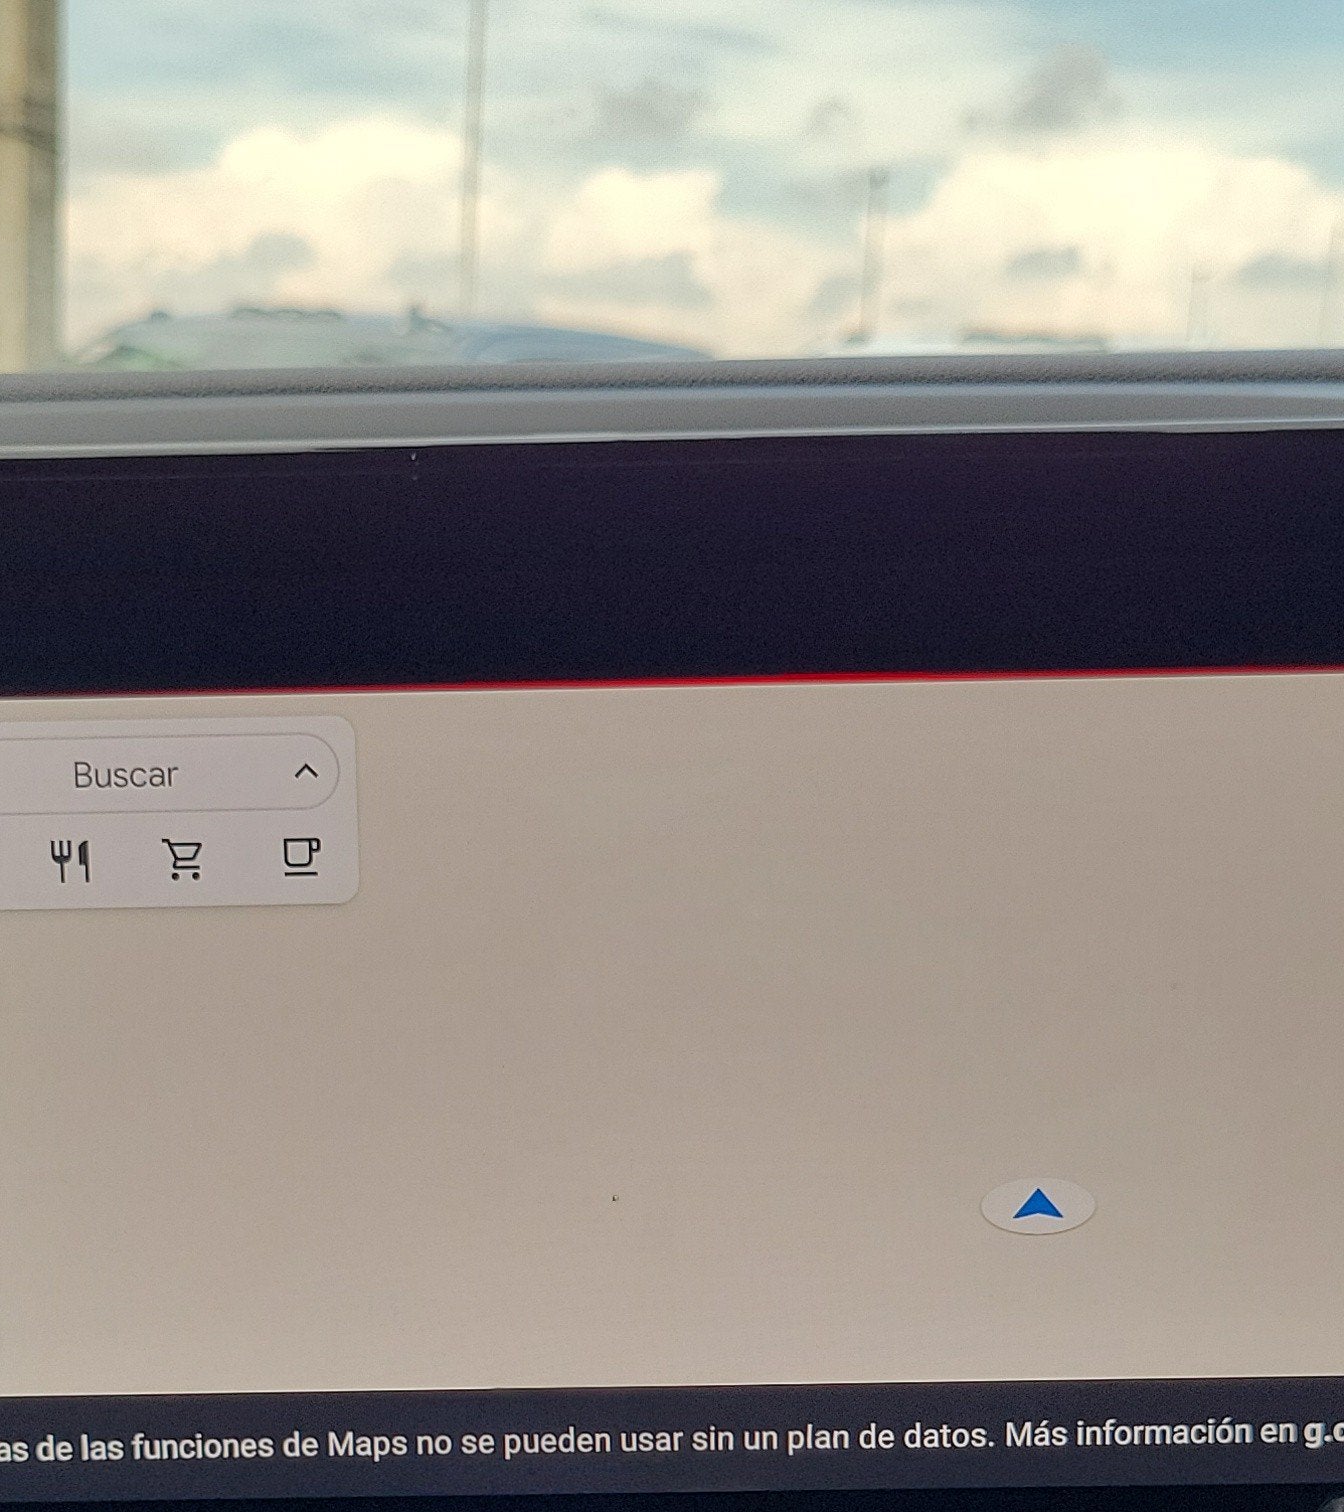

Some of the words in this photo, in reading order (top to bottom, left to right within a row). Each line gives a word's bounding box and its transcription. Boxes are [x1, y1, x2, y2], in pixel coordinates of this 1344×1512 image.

[73, 761, 179, 788] Buscar
[35, 1434, 74, 1462] de
[80, 1433, 124, 1461] las
[131, 1431, 275, 1460] funciones
[282, 1430, 319, 1458] de
[328, 1431, 408, 1463] Maps
[416, 1435, 452, 1455] no
[461, 1434, 495, 1455] se
[504, 1426, 611, 1461] pueden
[620, 1431, 684, 1452] usar
[691, 1425, 734, 1451] sin
[744, 1430, 778, 1451] un
[787, 1423, 850, 1457] plan
[859, 1422, 895, 1450] de
[903, 1421, 995, 1449] datos.
[1005, 1418, 1068, 1447] Más
[1076, 1415, 1253, 1446] información
[1260, 1422, 1298, 1444] en
